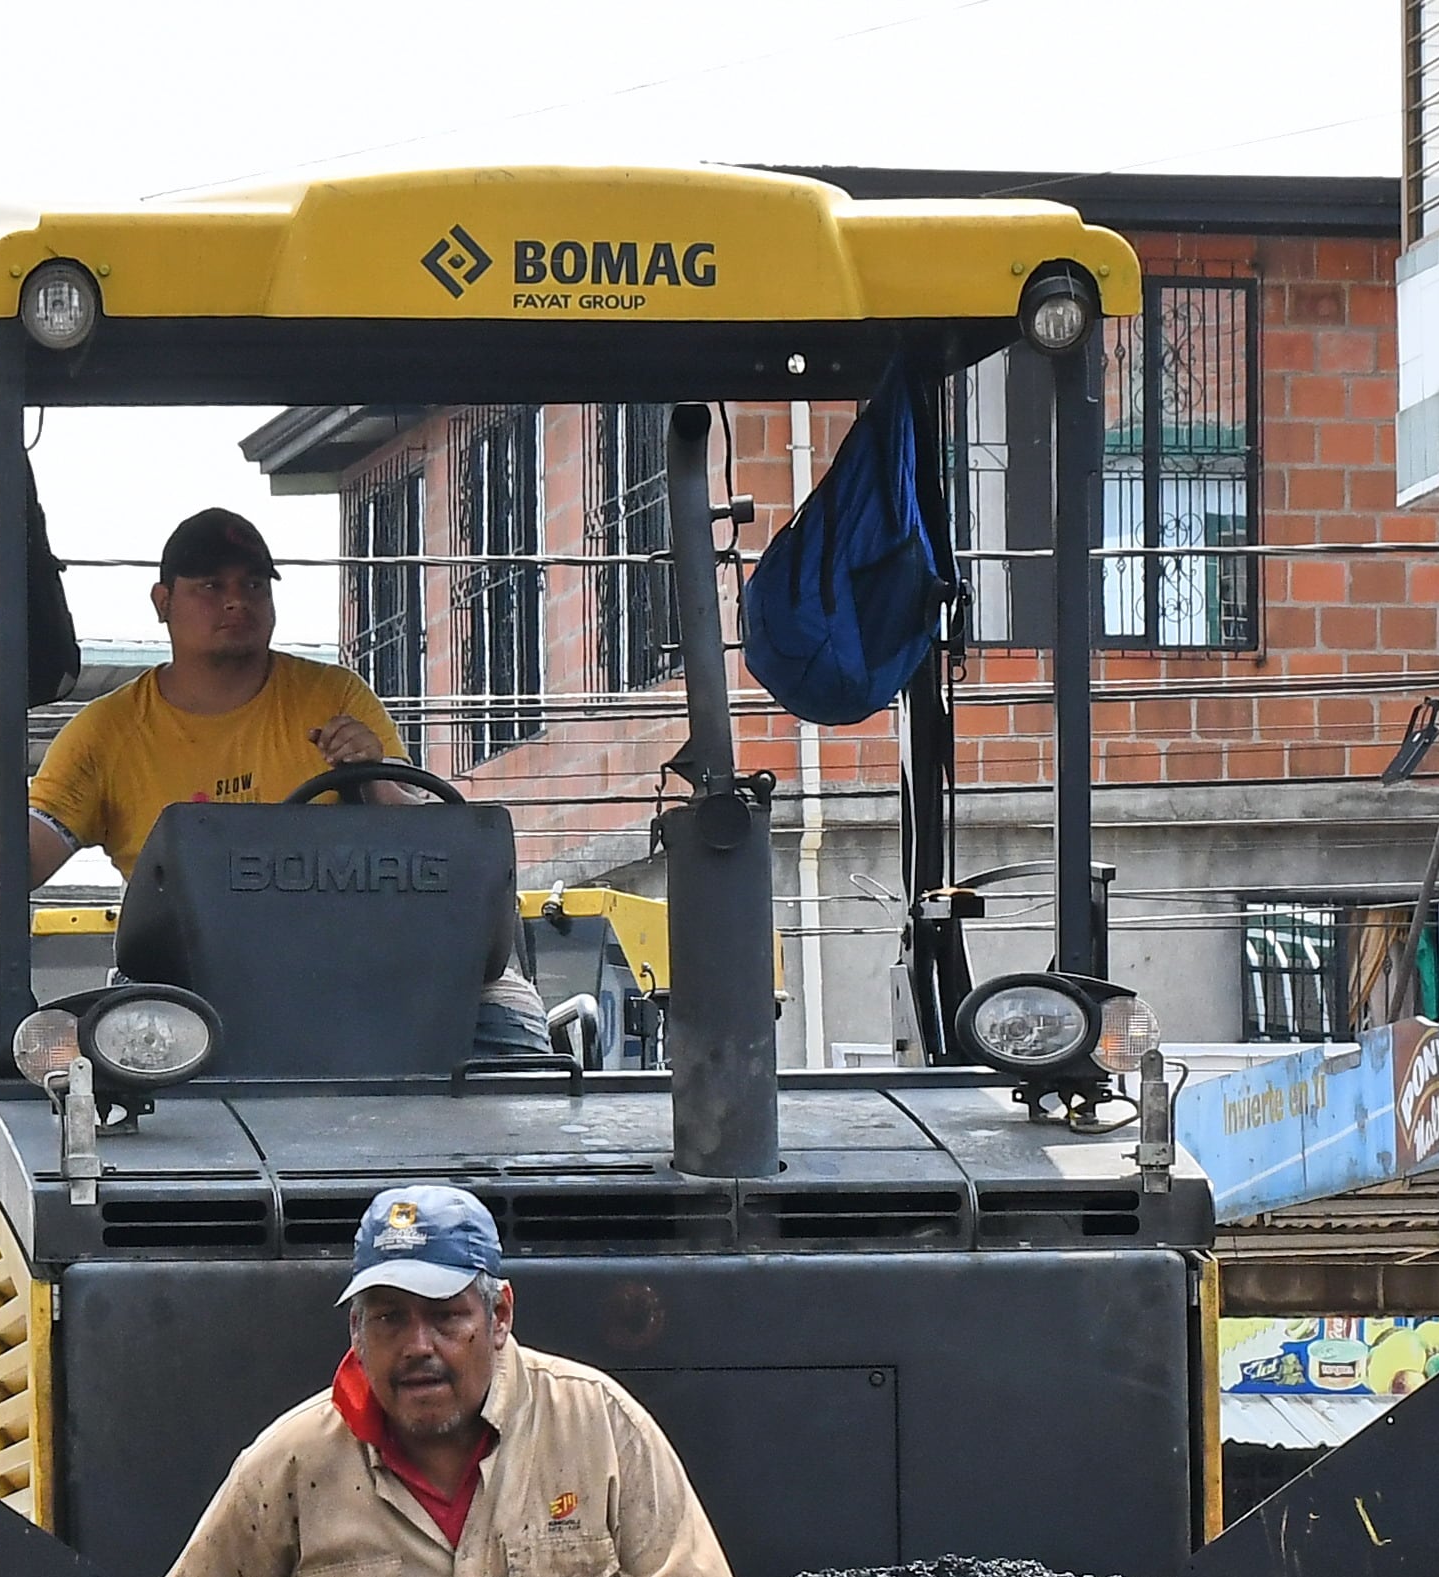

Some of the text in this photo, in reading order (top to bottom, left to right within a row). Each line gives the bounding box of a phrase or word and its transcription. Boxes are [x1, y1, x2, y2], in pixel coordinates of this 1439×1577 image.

[514, 240, 717, 287] BOMAG
[513, 294, 646, 310] FAYAT GROUP
[216, 772, 253, 796] SLOW
[229, 850, 449, 893] BOMAG
[1223, 1079, 1285, 1136] Invierte
